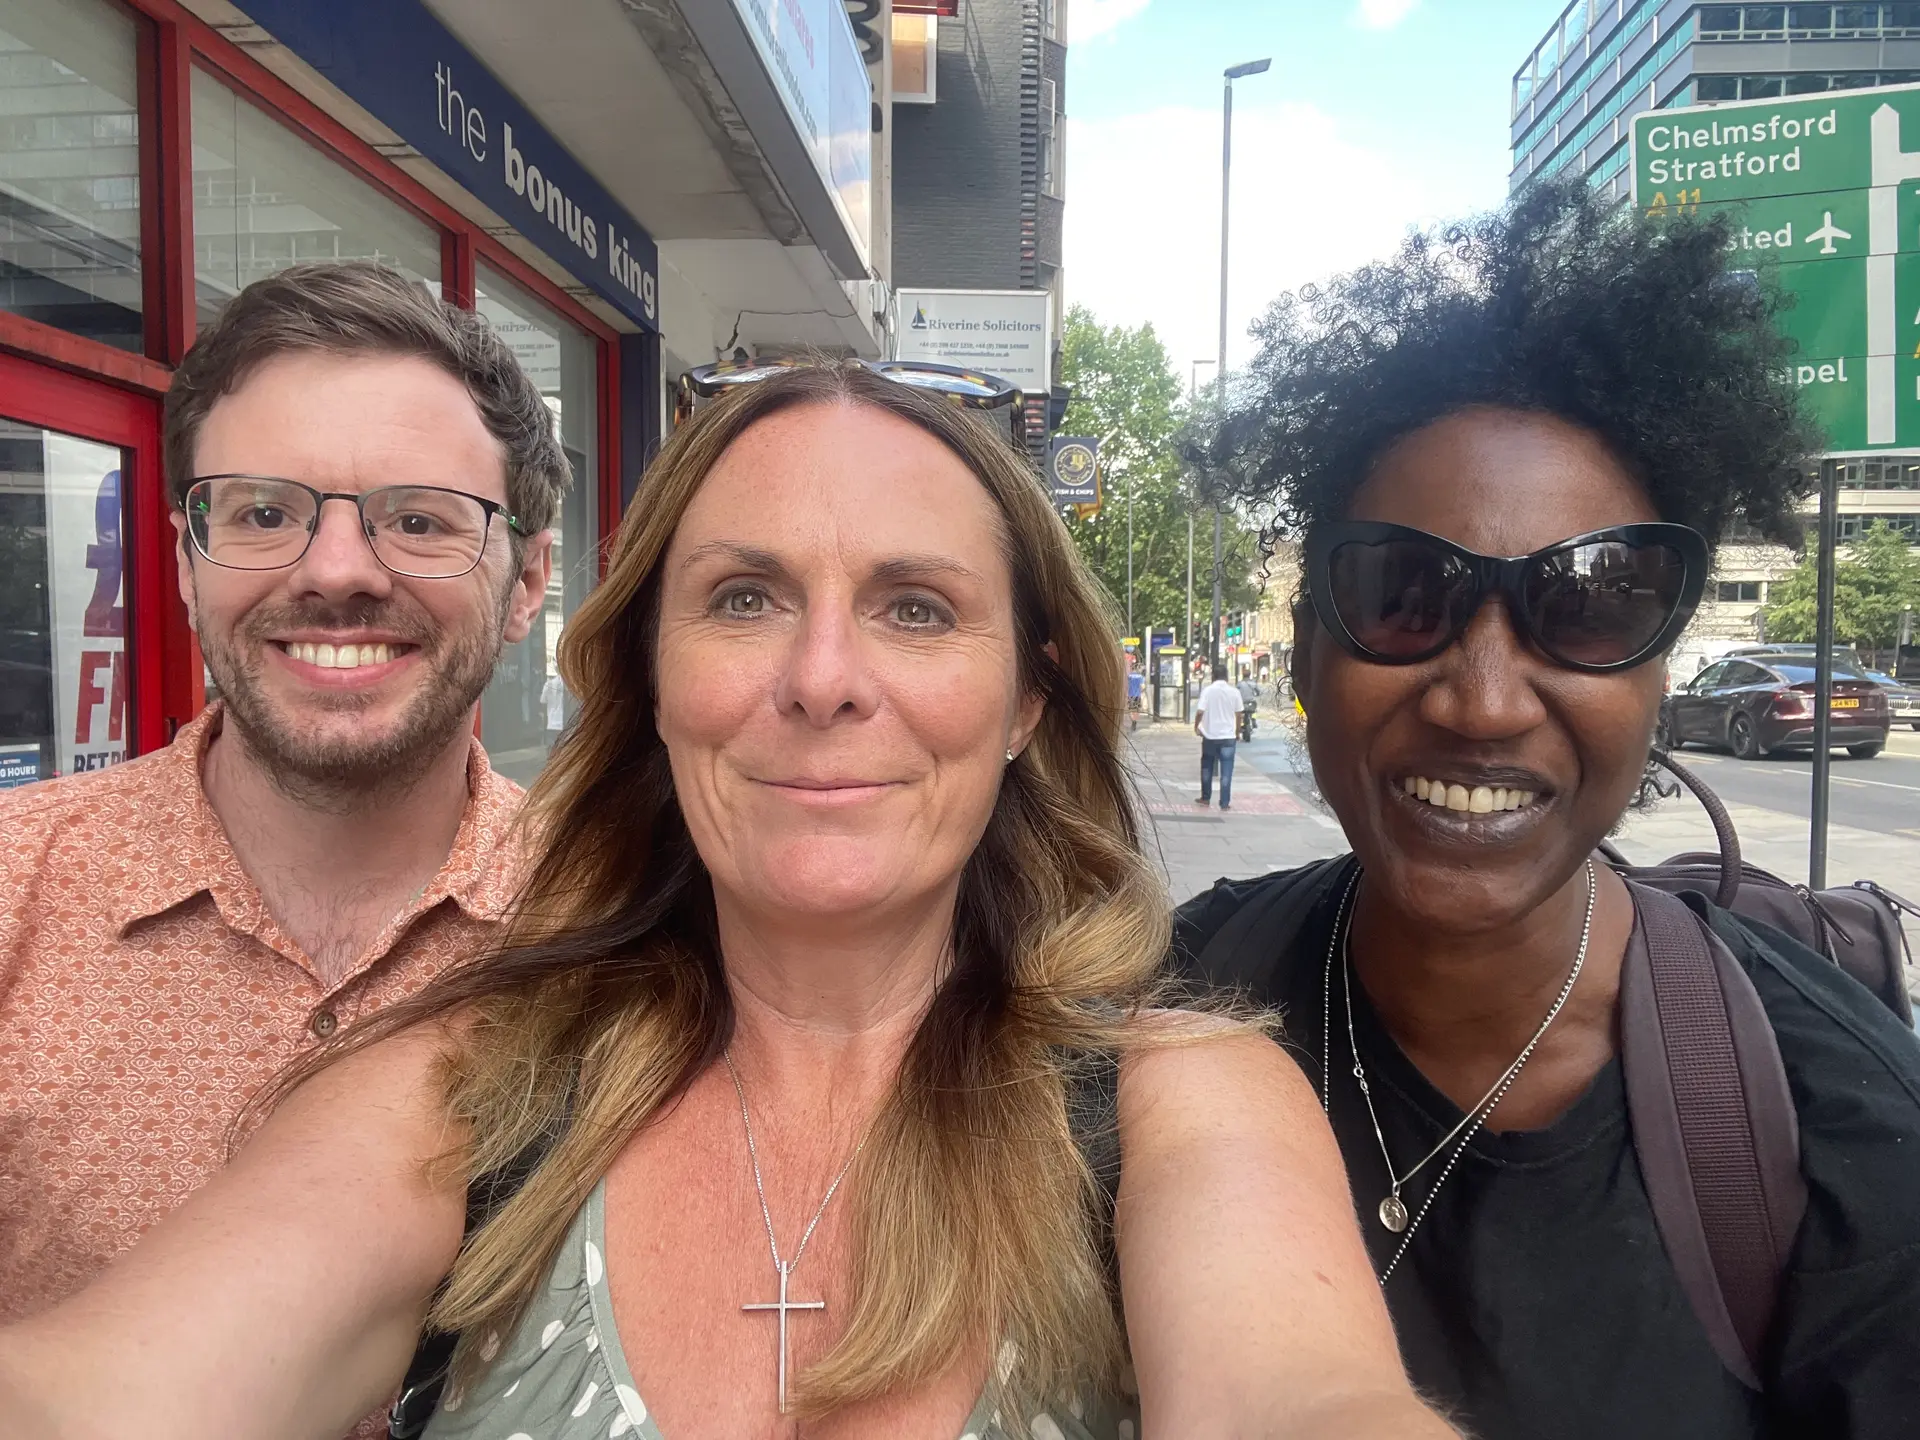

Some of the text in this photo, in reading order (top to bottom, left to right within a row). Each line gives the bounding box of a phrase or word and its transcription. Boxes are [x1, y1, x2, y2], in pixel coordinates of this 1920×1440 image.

[1648, 109, 1836, 151] Chelmsford
[1649, 146, 1800, 184] Stratford
[435, 61, 656, 320] the bonus king
[1645, 188, 1701, 218] A11
[1723, 222, 1792, 252] sted
[929, 319, 1042, 332] Riverine Solicitors
[7, 766, 37, 778] HOURS
